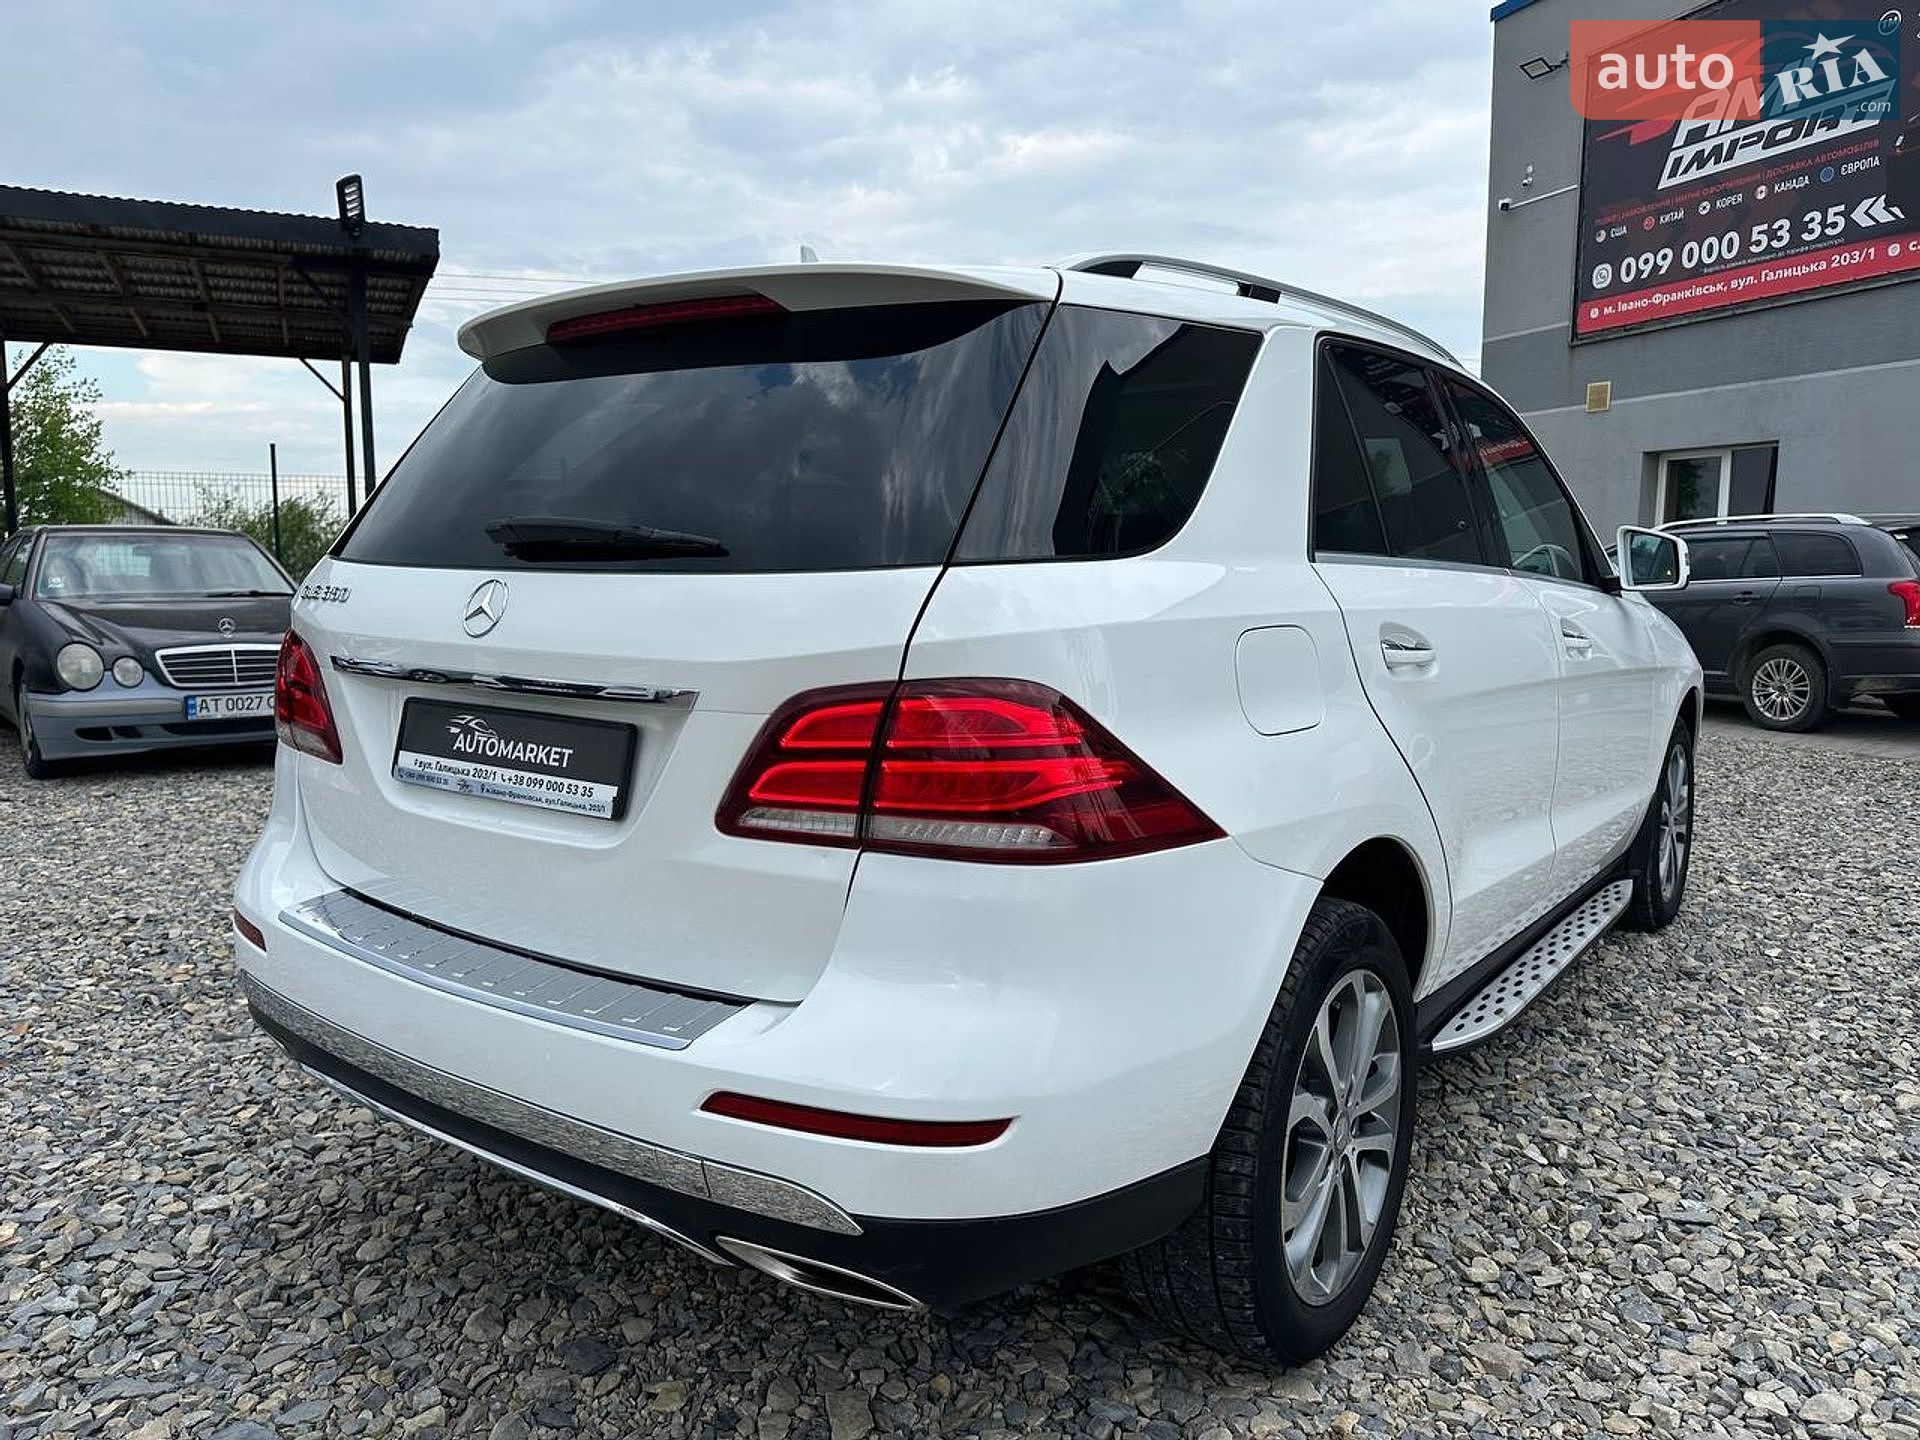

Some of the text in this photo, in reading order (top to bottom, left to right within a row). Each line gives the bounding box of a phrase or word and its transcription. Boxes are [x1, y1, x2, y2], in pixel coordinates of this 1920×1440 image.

[1664, 88, 1892, 182] IMPORT
[1840, 156, 1881, 176] ЄВРОПА
[1773, 175, 1811, 194] КАНАДА
[1715, 193, 1744, 210] КОРЕЯ
[1658, 208, 1685, 225] КИТАЙ
[1609, 225, 1628, 239] США
[1619, 247, 1674, 284] 099
[1681, 231, 1740, 269] 000
[1749, 218, 1791, 254] 53
[1800, 204, 1847, 242] 35
[1617, 281, 1728, 313] Івано-Франківськ,
[1730, 275, 1758, 290] вул.
[1761, 260, 1828, 283] Галицька
[1831, 247, 1876, 268] 203/1
[199, 697, 223, 713] AT
[225, 696, 264, 712] 0027
[452, 733, 574, 768] AUTOMARKET
[435, 761, 471, 777] Галицька
[471, 768, 498, 781] 203/1
[507, 774, 525, 786] +38
[526, 777, 545, 789] 099
[545, 780, 565, 793] 000
[565, 783, 579, 795] 53
[580, 786, 595, 798] 35
